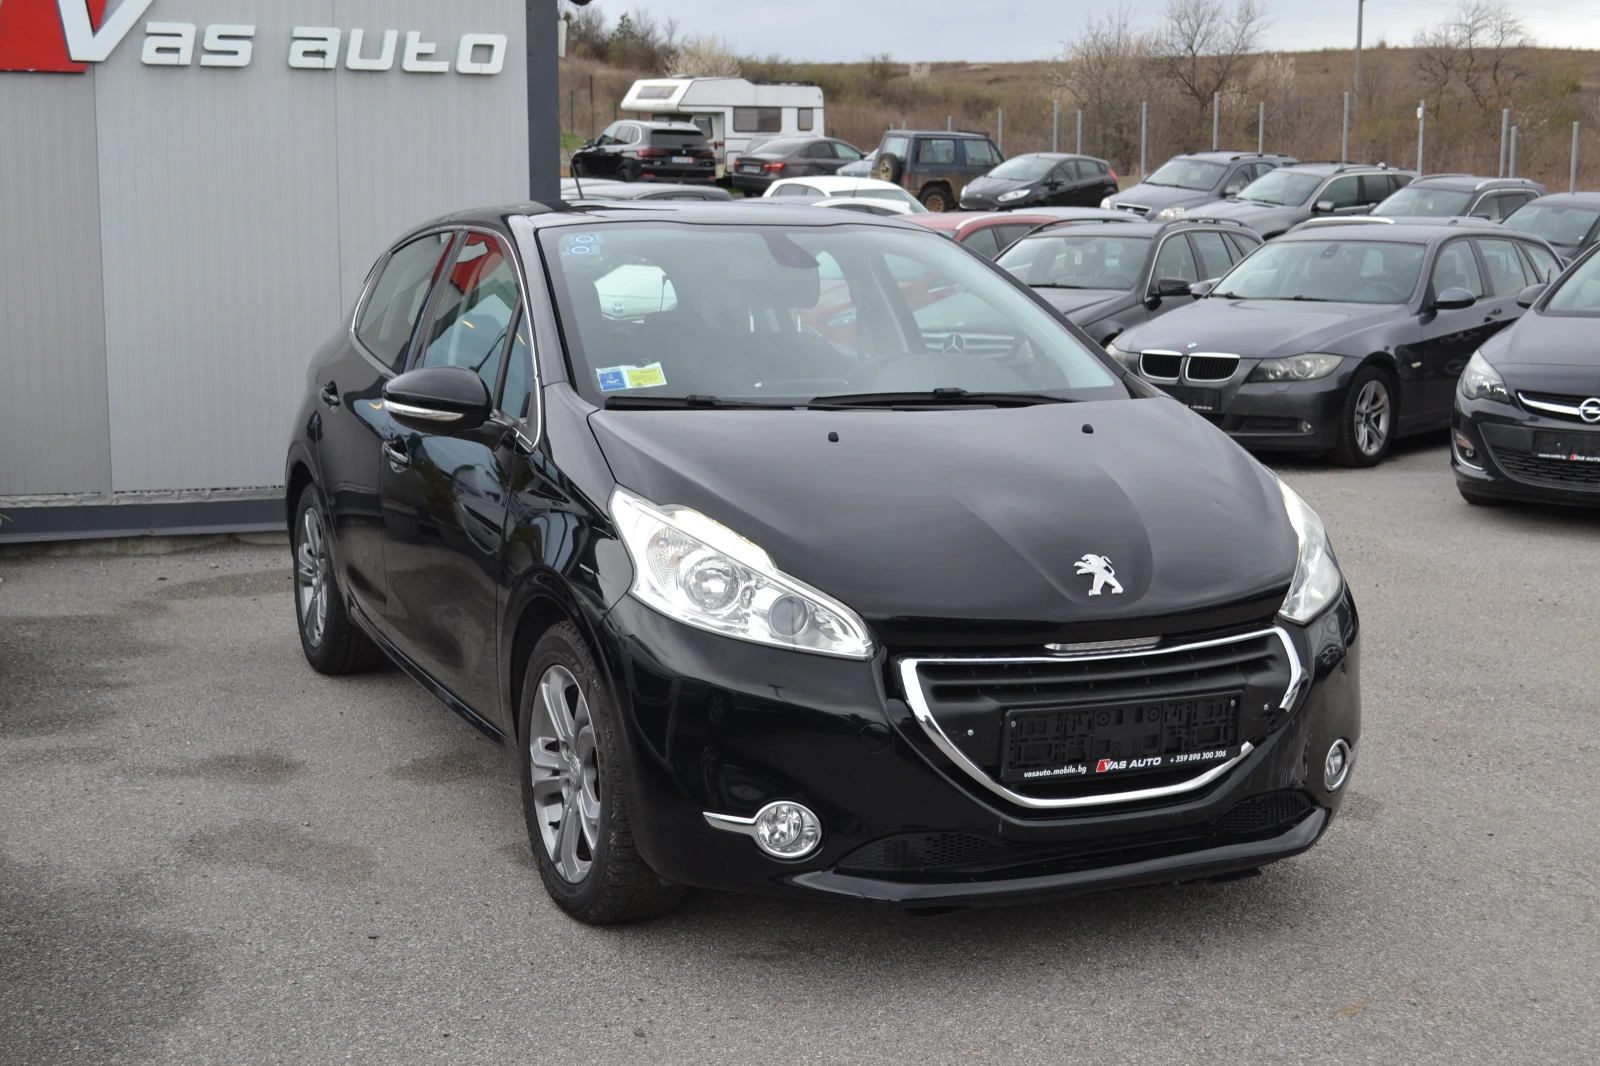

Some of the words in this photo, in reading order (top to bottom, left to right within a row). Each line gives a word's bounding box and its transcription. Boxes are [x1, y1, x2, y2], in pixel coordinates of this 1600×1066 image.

[57, 0, 255, 67] Vas
[288, 26, 507, 74] auto
[1175, 754, 1188, 763] 359
[1188, 752, 1201, 762] 898
[1201, 751, 1214, 760] 300
[1214, 750, 1226, 759] 306
[1023, 764, 1087, 778] vasauto.mobile.bg
[1103, 759, 1127, 771] VAS
[1131, 757, 1162, 769] AUTO
